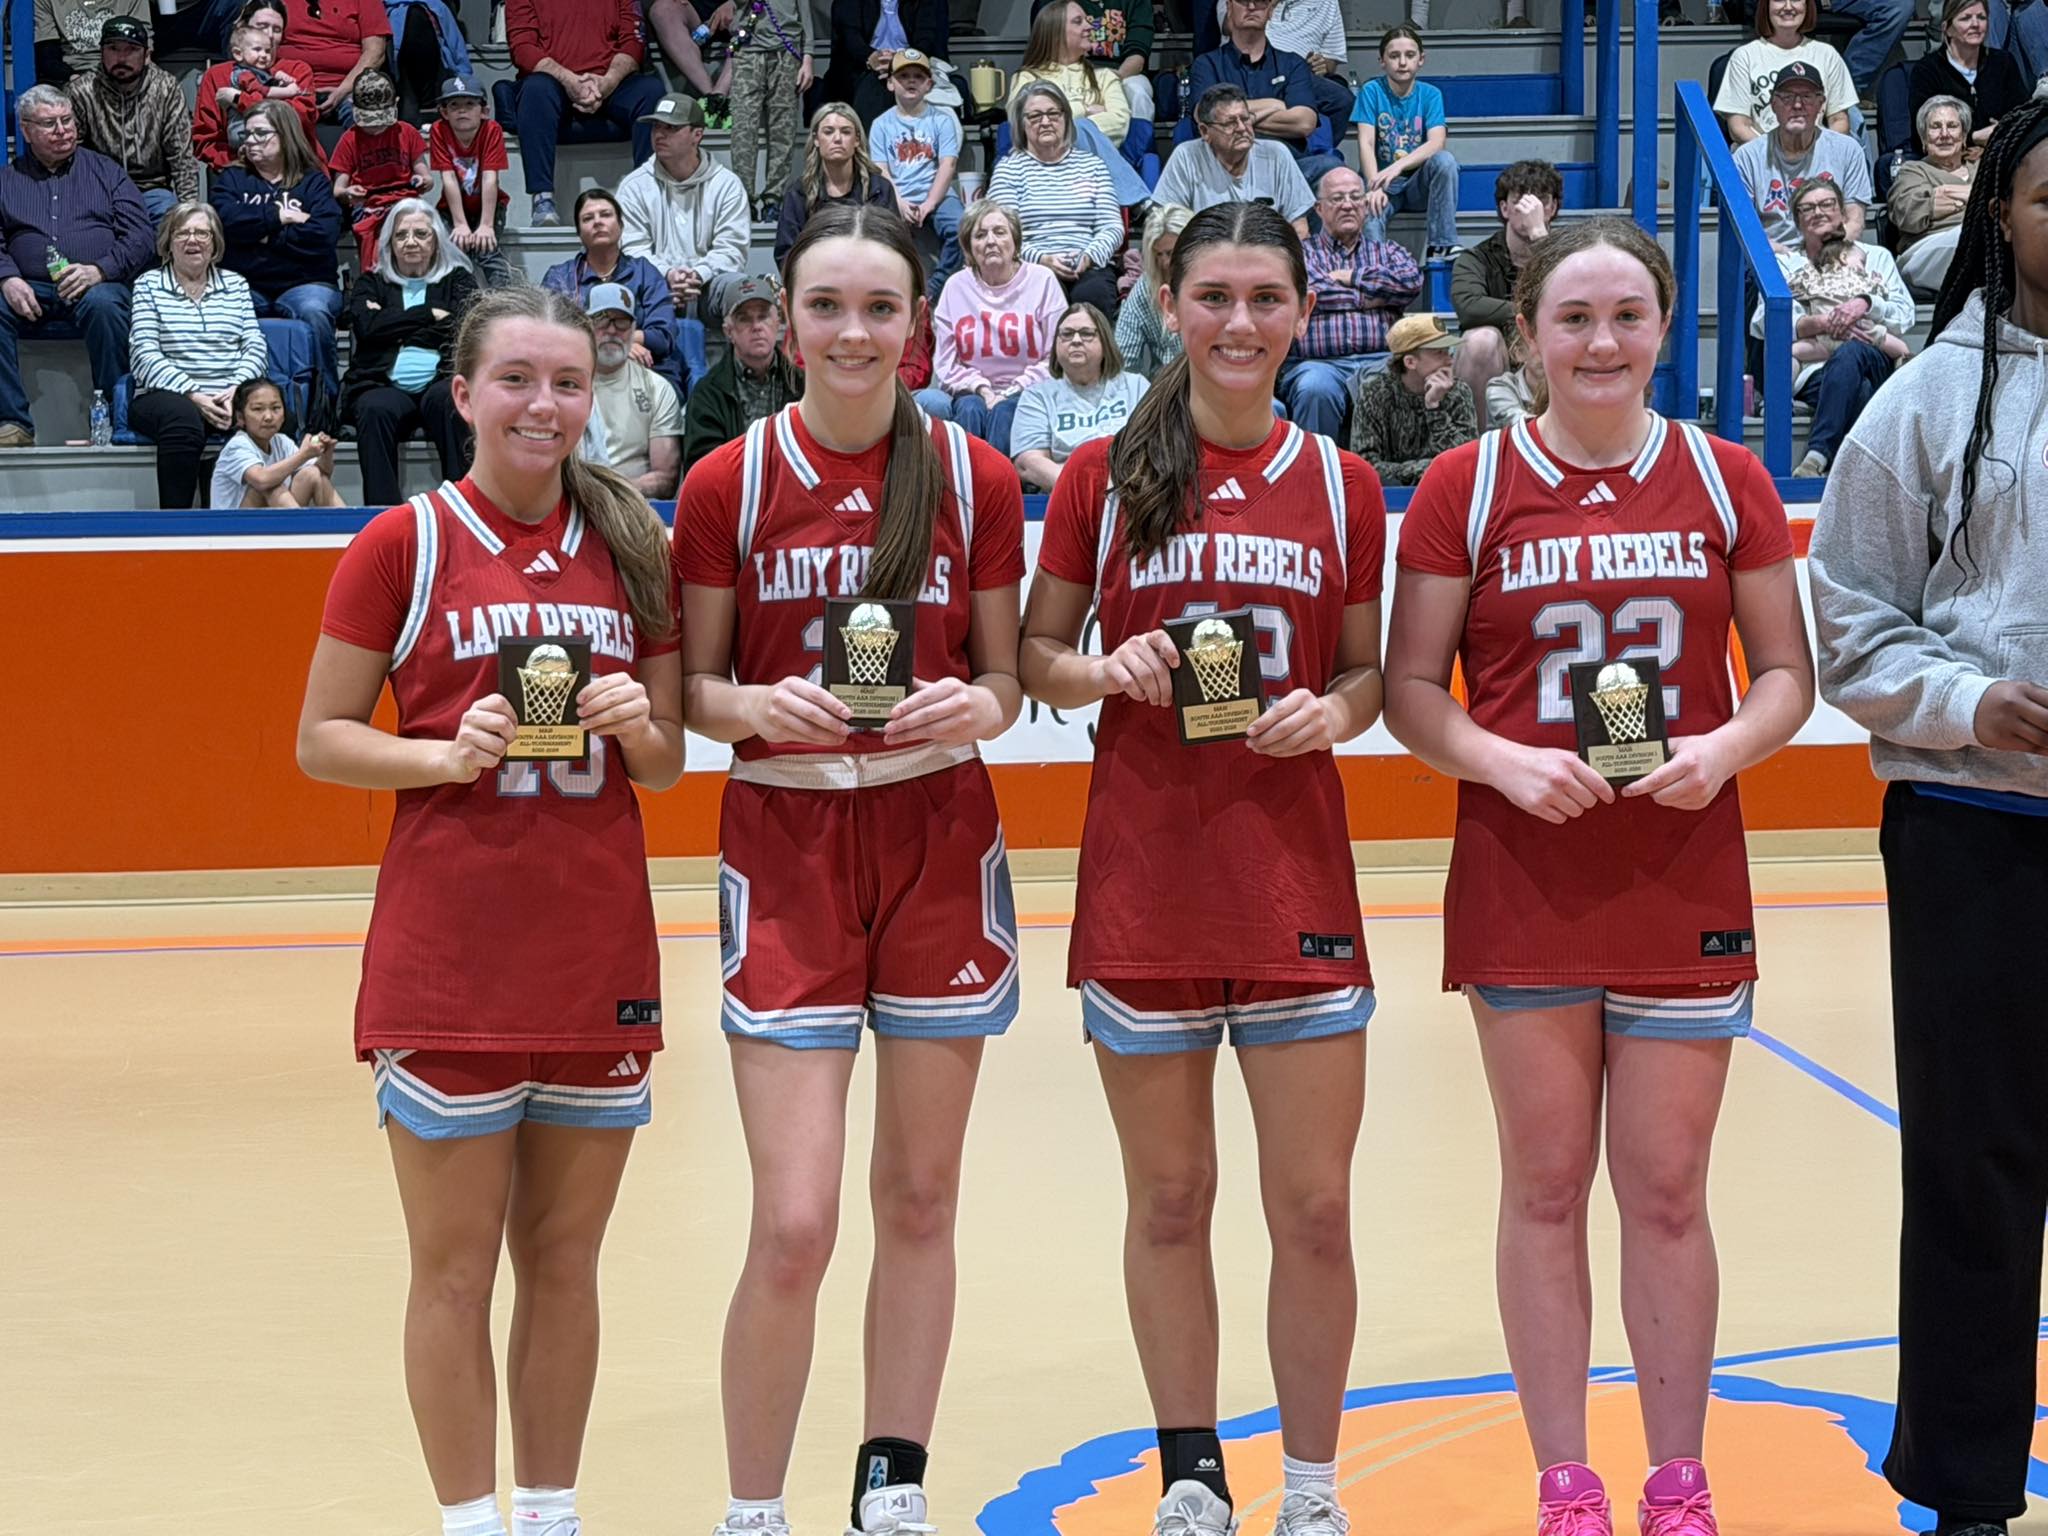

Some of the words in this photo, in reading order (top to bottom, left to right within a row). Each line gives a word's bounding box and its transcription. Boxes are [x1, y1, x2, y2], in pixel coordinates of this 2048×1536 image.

[955, 311, 1040, 361] GIGI
[754, 546, 834, 603] LADY
[1130, 533, 1209, 591] LADY
[1214, 532, 1324, 598] REBELS
[1499, 536, 1582, 593] LADY
[1588, 531, 1710, 580] REBELS
[1530, 596, 1685, 724] 22
